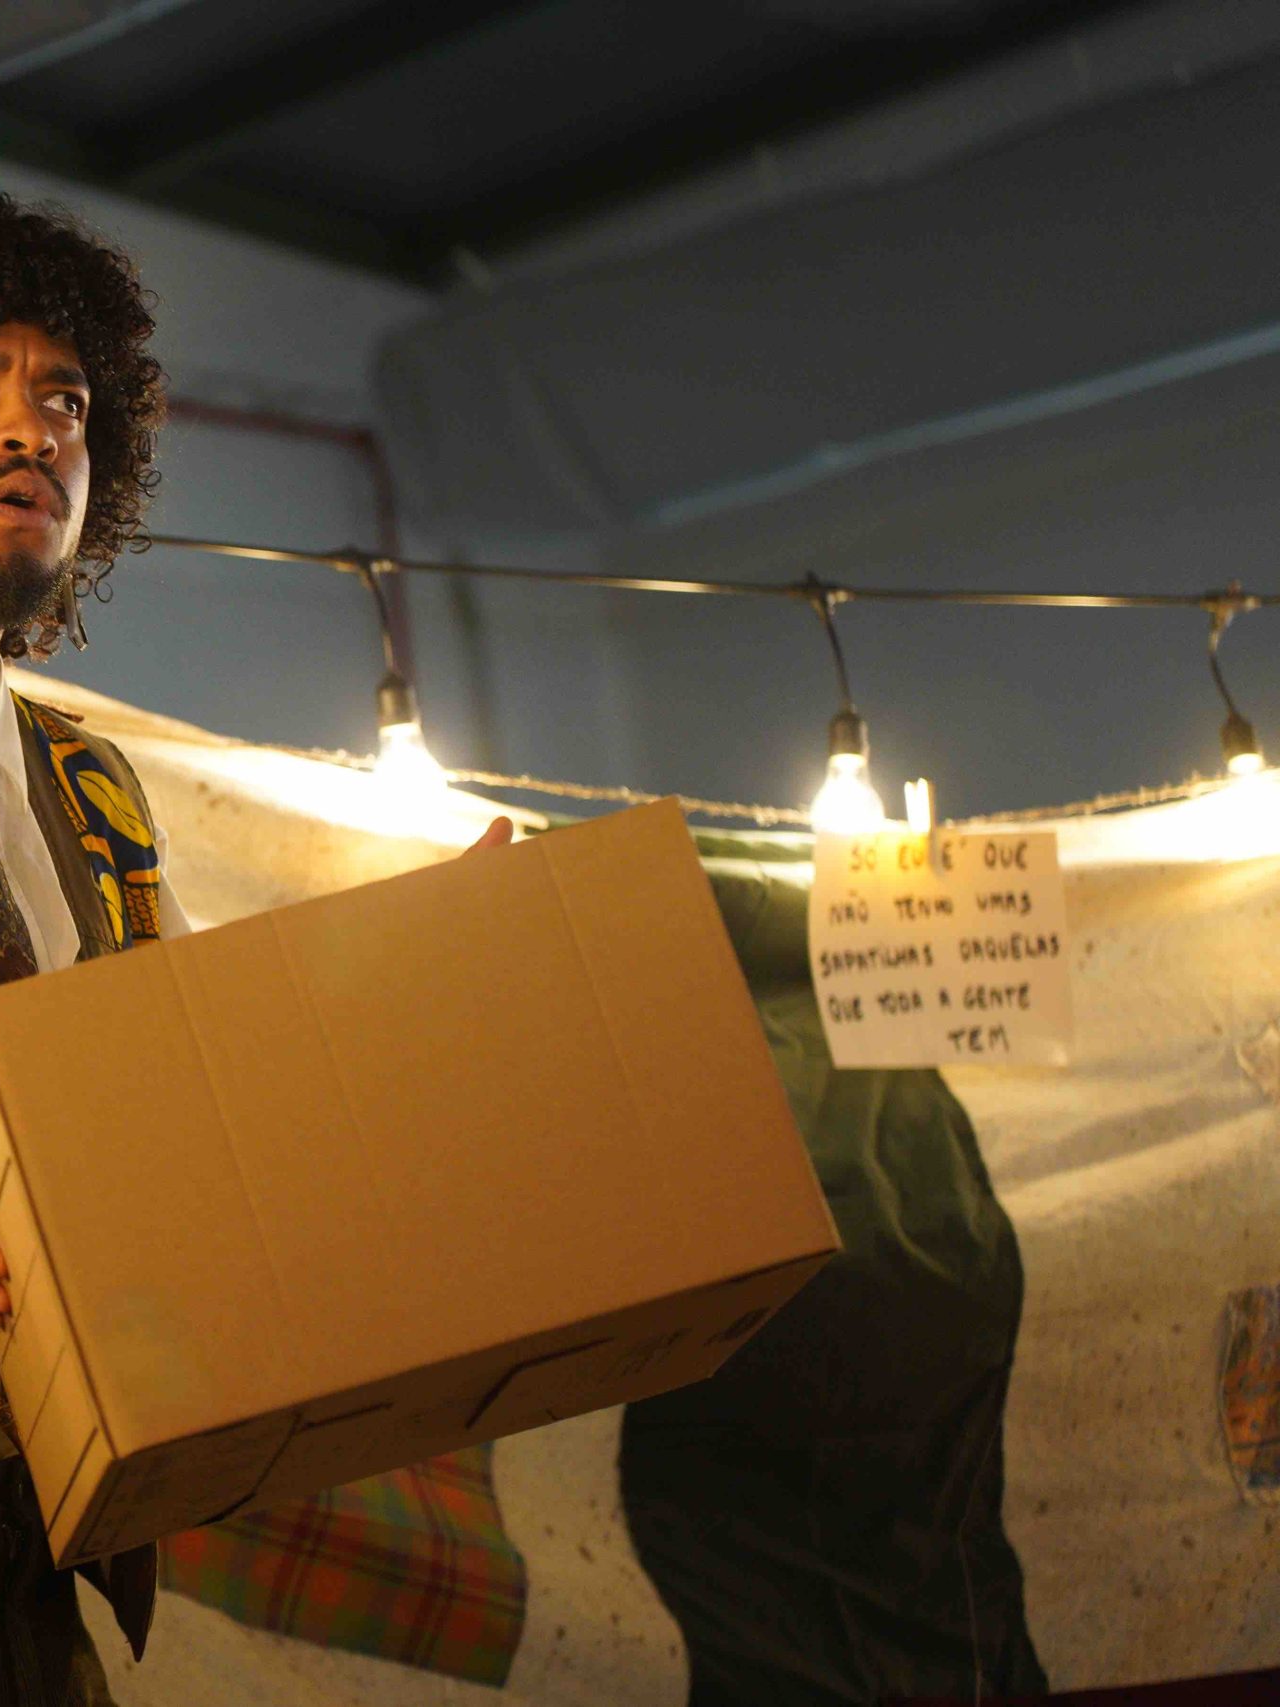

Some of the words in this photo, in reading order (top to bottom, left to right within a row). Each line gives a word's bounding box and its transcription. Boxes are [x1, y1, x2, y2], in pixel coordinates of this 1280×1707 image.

[828, 889, 869, 925] NÃO
[976, 890, 1032, 916] UMAS
[820, 943, 934, 978] SAPATILHAS
[959, 932, 1060, 962] DAQUELAS
[827, 994, 864, 1022] QUE
[876, 990, 923, 1014] TODA
[938, 986, 951, 1009] A
[963, 982, 1031, 1010] GENTE
[947, 1023, 1010, 1054] TEM
